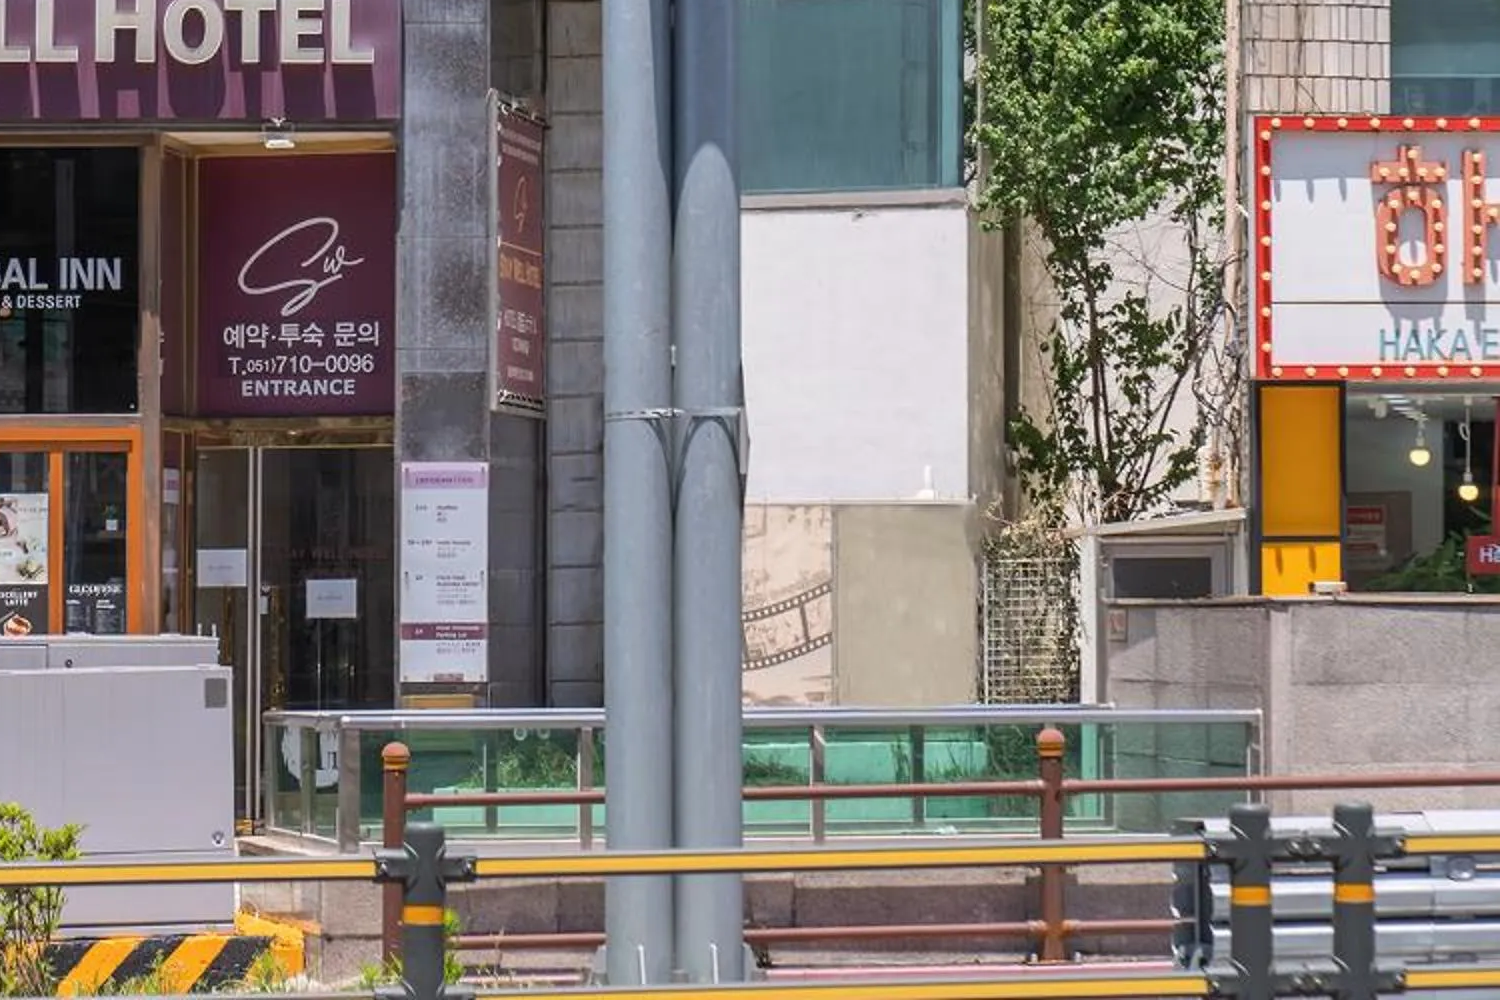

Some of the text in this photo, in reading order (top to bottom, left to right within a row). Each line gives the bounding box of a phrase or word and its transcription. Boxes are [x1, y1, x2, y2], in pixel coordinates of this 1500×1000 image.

[59, 256, 122, 291] INN
[16, 294, 82, 309] DESSERT
[333, 321, 380, 347] 문의
[241, 379, 356, 397] ENTRANCE
